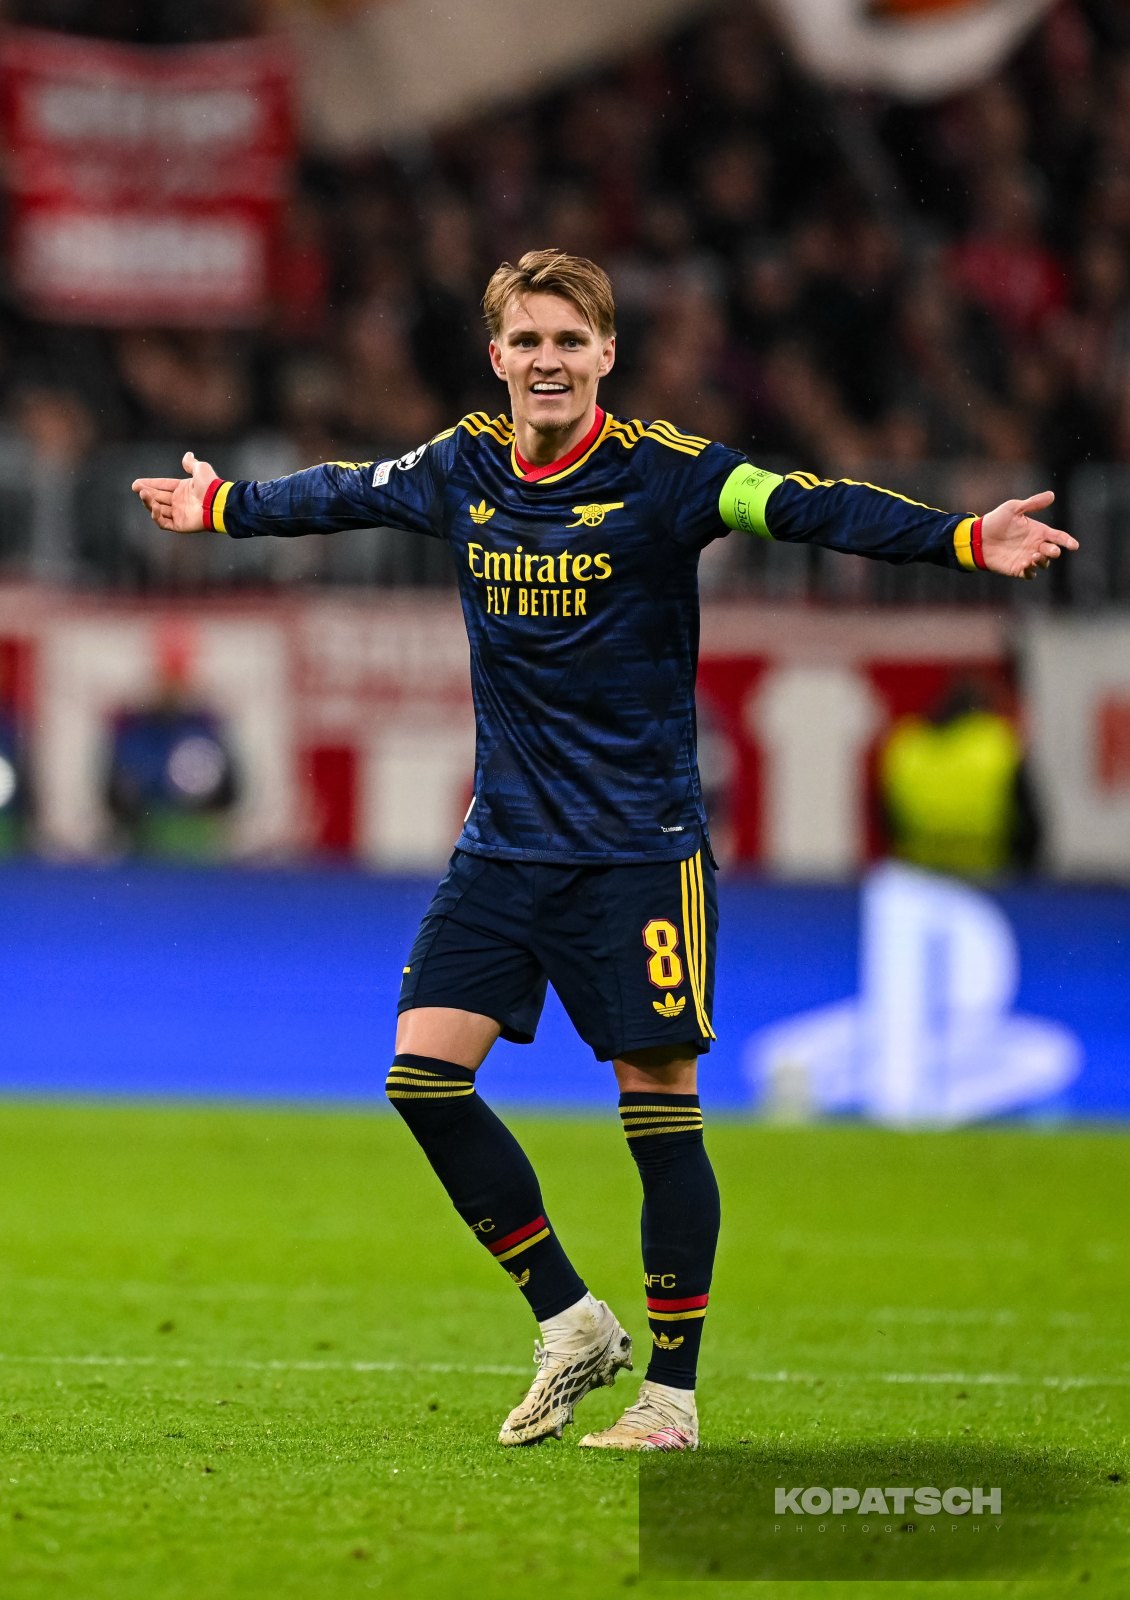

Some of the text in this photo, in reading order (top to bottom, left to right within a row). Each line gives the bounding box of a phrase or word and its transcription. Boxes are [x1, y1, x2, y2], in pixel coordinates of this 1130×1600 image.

[737, 499, 750, 531] SPECT
[467, 542, 613, 583] Emirates
[486, 586, 588, 617] FLY BETTER
[642, 918, 684, 990] 8
[470, 1218, 496, 1234] FC
[643, 1272, 676, 1289] AFC
